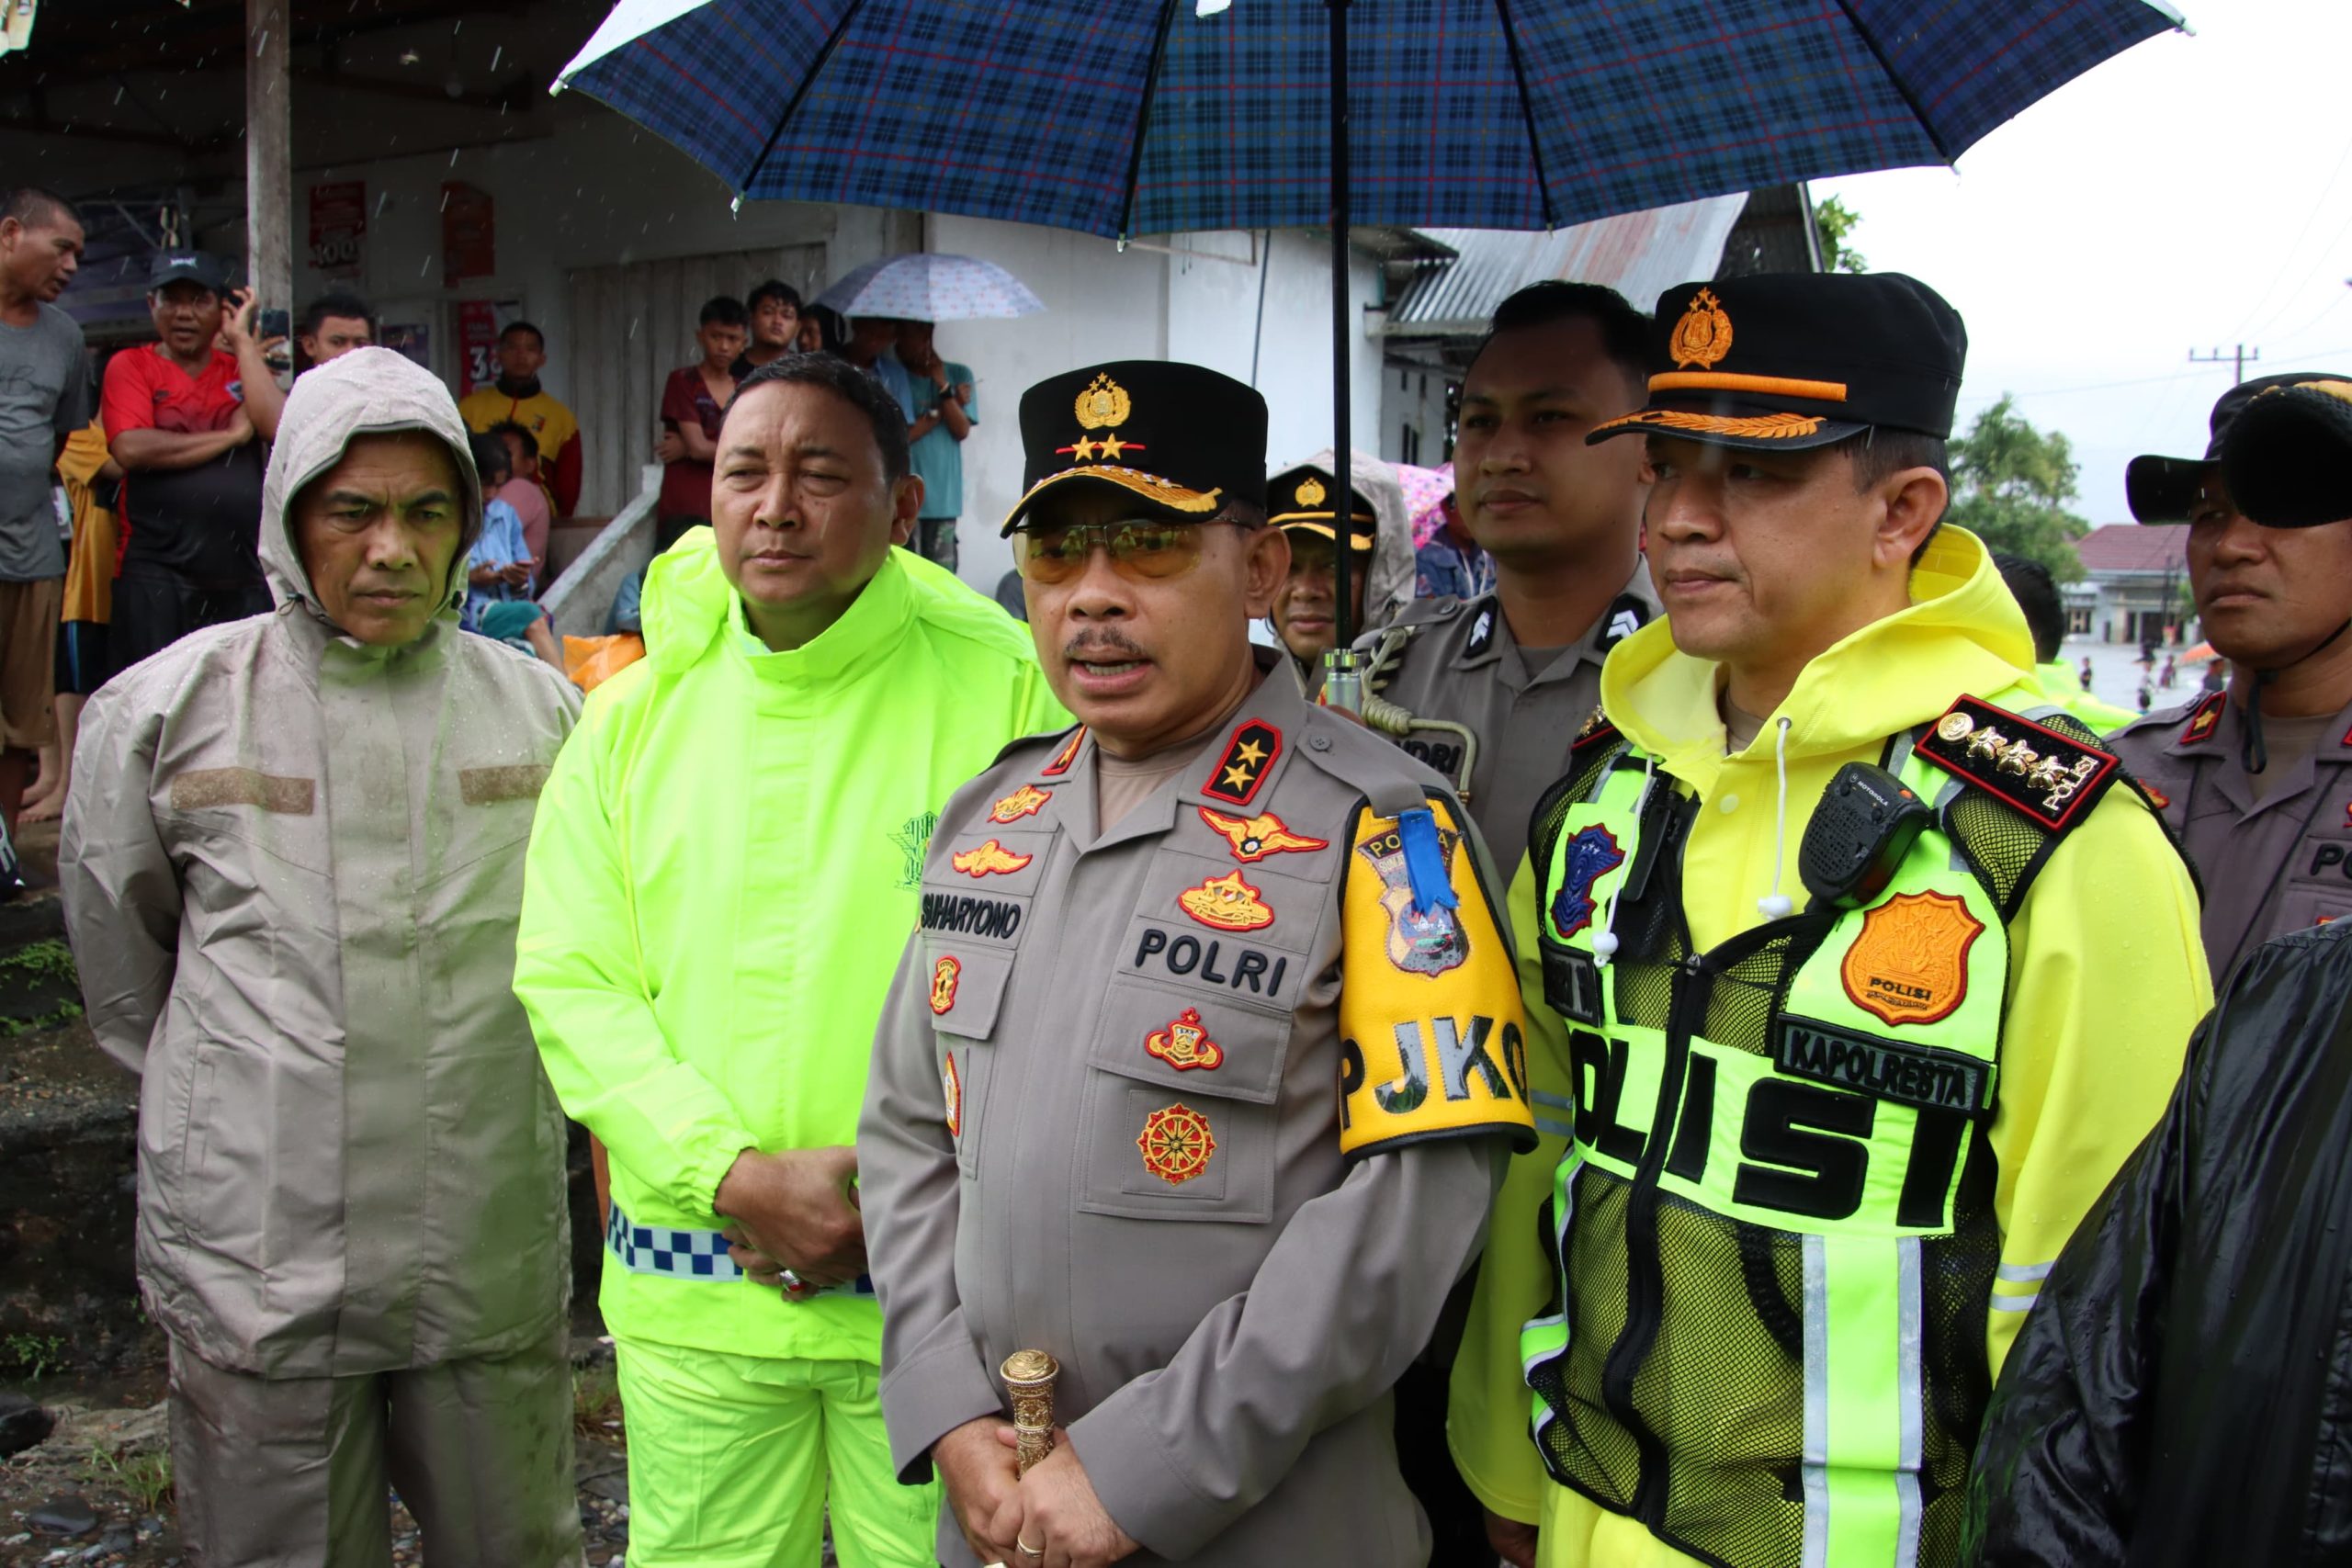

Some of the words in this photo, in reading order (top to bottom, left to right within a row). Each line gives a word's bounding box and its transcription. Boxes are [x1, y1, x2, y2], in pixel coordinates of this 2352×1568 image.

[1857, 780, 1889, 807] MOTOROLA
[1370, 829, 1449, 858] POA
[921, 893, 1021, 940] SUHARYONO
[1135, 929, 1287, 998] POLRI
[1870, 976, 1932, 1001] POLISI
[1792, 1030, 1967, 1106] KAPOLRESTA
